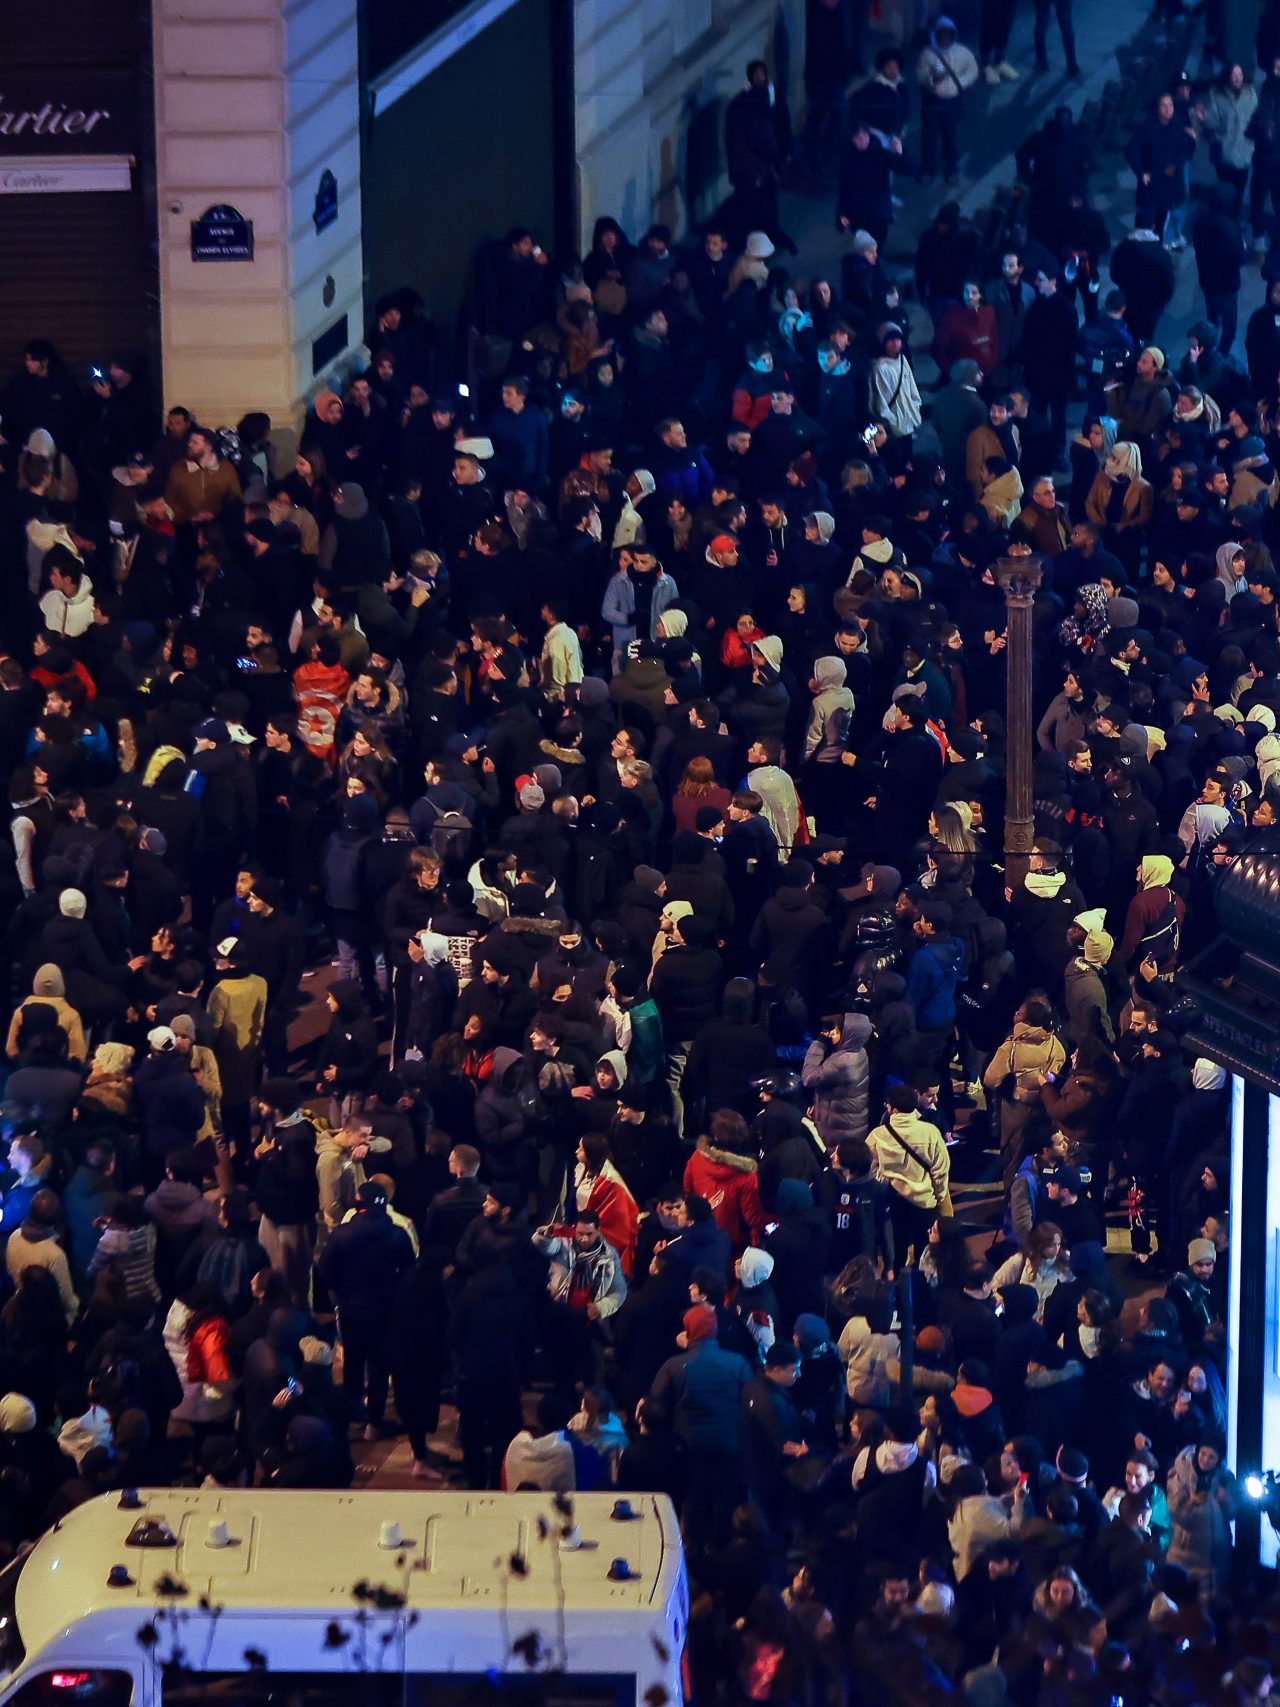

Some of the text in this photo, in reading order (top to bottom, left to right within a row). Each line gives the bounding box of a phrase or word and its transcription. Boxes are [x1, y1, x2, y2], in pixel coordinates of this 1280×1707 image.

[0, 96, 112, 135] artier
[1203, 1012, 1268, 1058] SPECTACLES
[836, 1212, 850, 1229] 18
